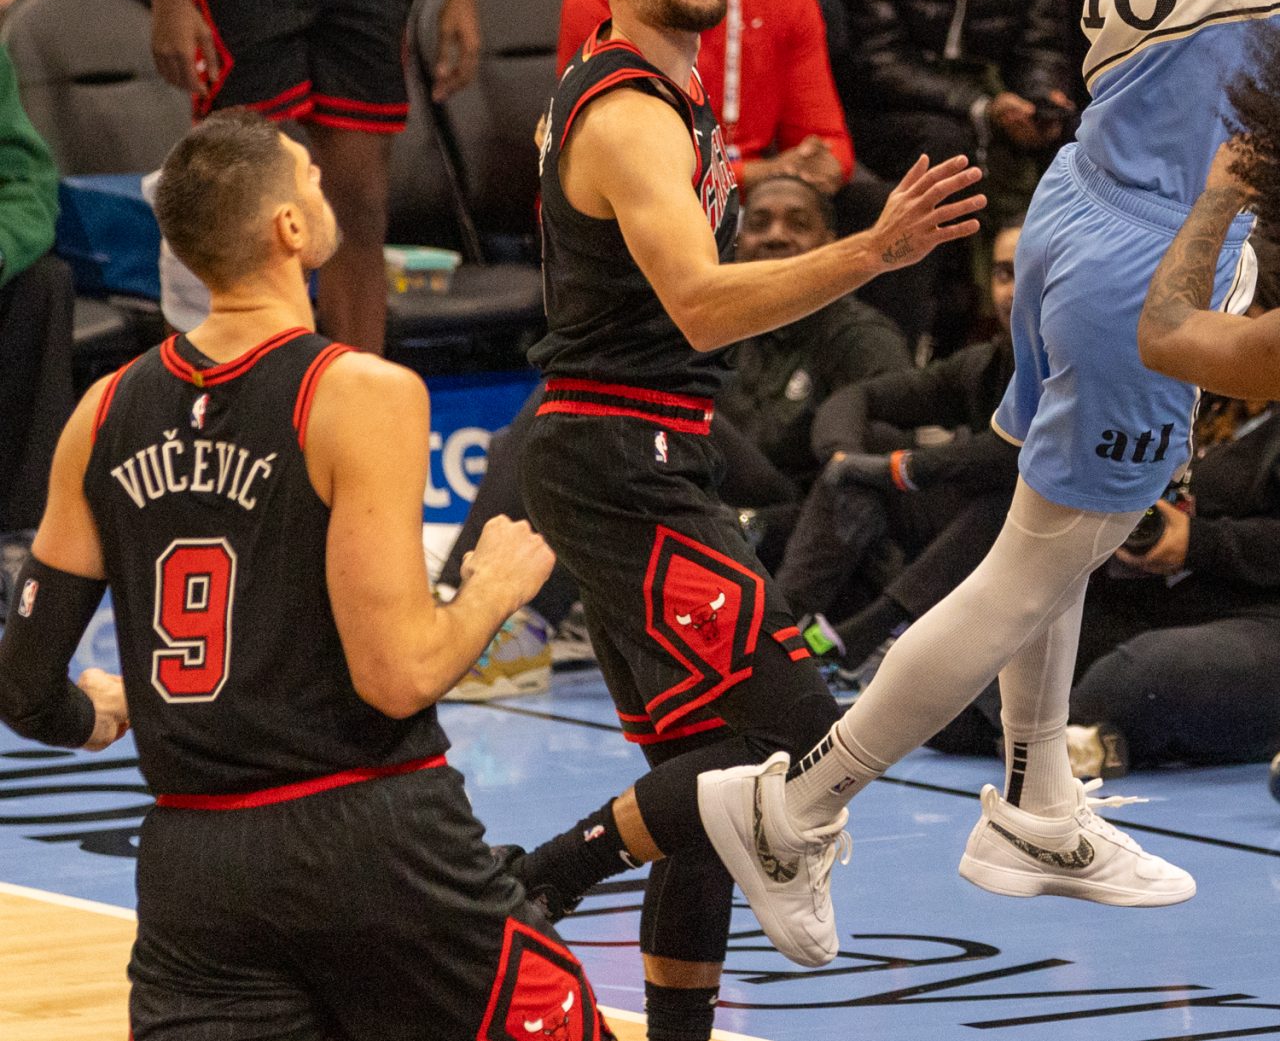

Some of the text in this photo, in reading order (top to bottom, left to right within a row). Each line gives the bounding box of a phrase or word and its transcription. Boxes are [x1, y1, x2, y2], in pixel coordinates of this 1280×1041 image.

[110, 427, 278, 510] VUČEVIĆ
[1095, 422, 1175, 463] atl
[151, 537, 237, 703] 9
